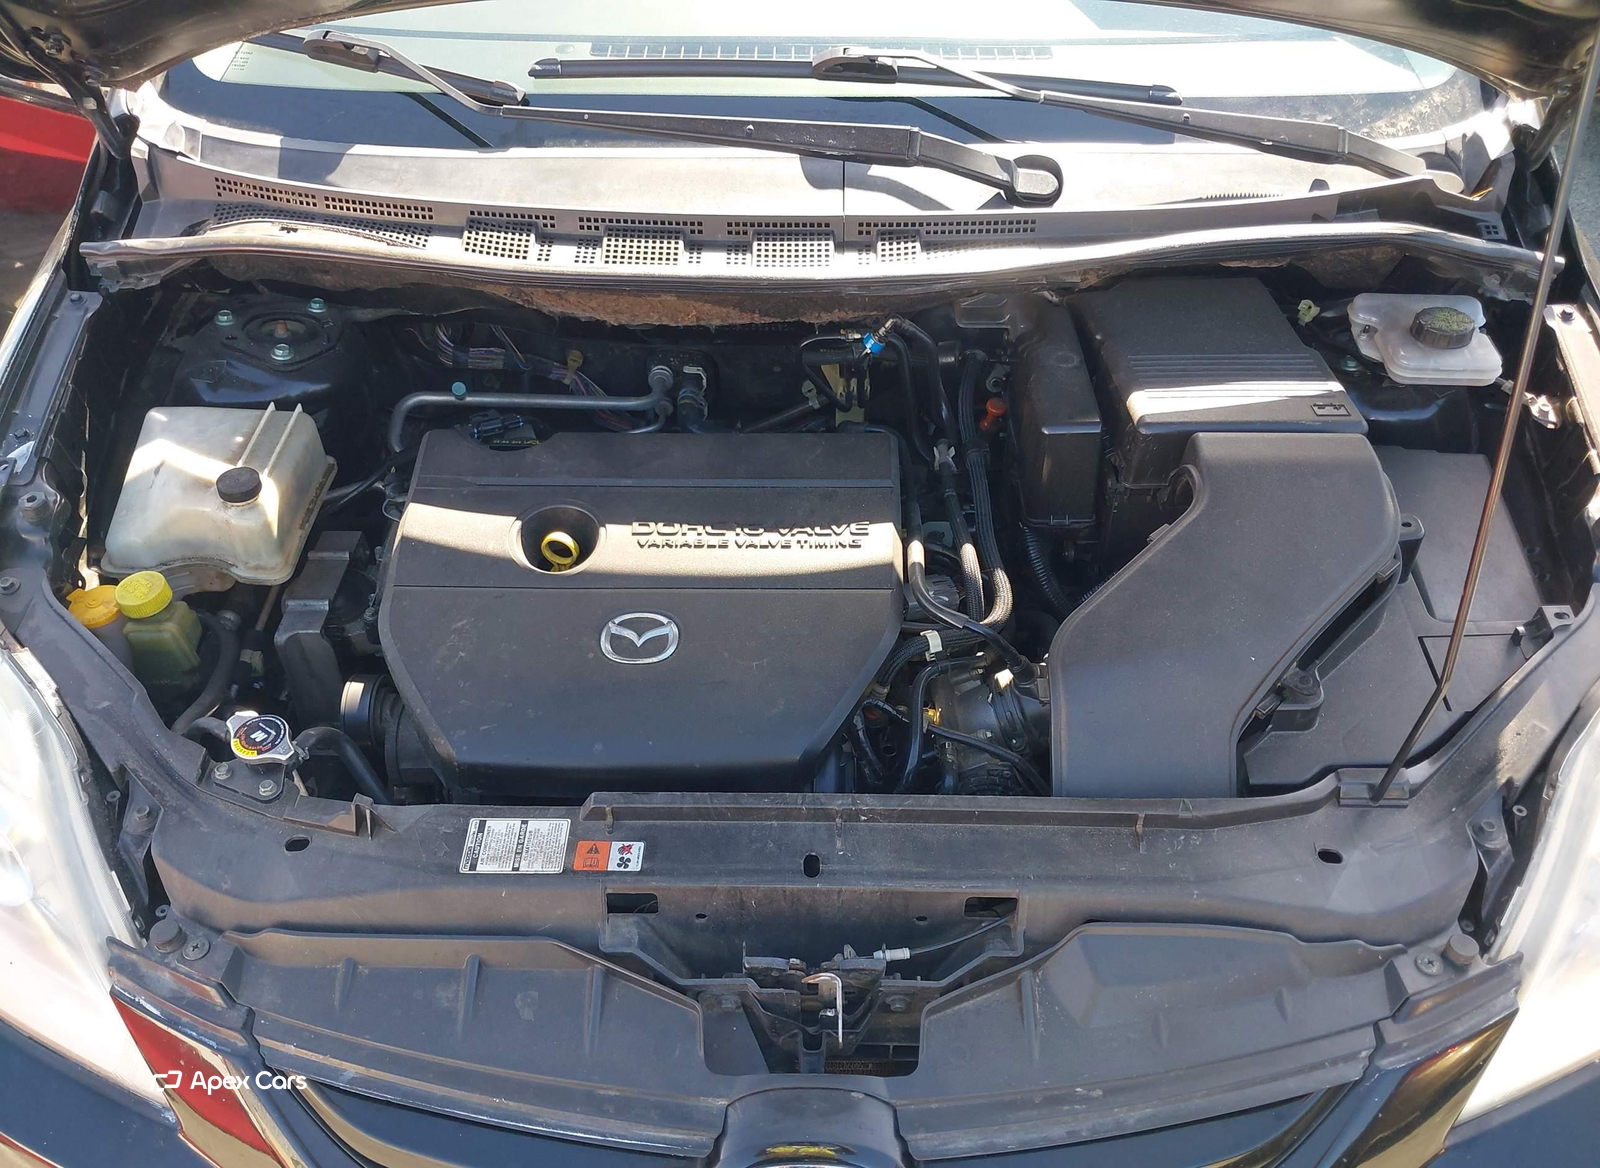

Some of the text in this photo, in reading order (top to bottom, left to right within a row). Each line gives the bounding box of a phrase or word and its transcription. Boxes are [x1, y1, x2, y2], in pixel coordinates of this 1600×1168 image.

[777, 521, 870, 537] VALVE
[636, 538, 862, 549] VARIABLE VALVE TIMING
[473, 832, 483, 858] CAUTION
